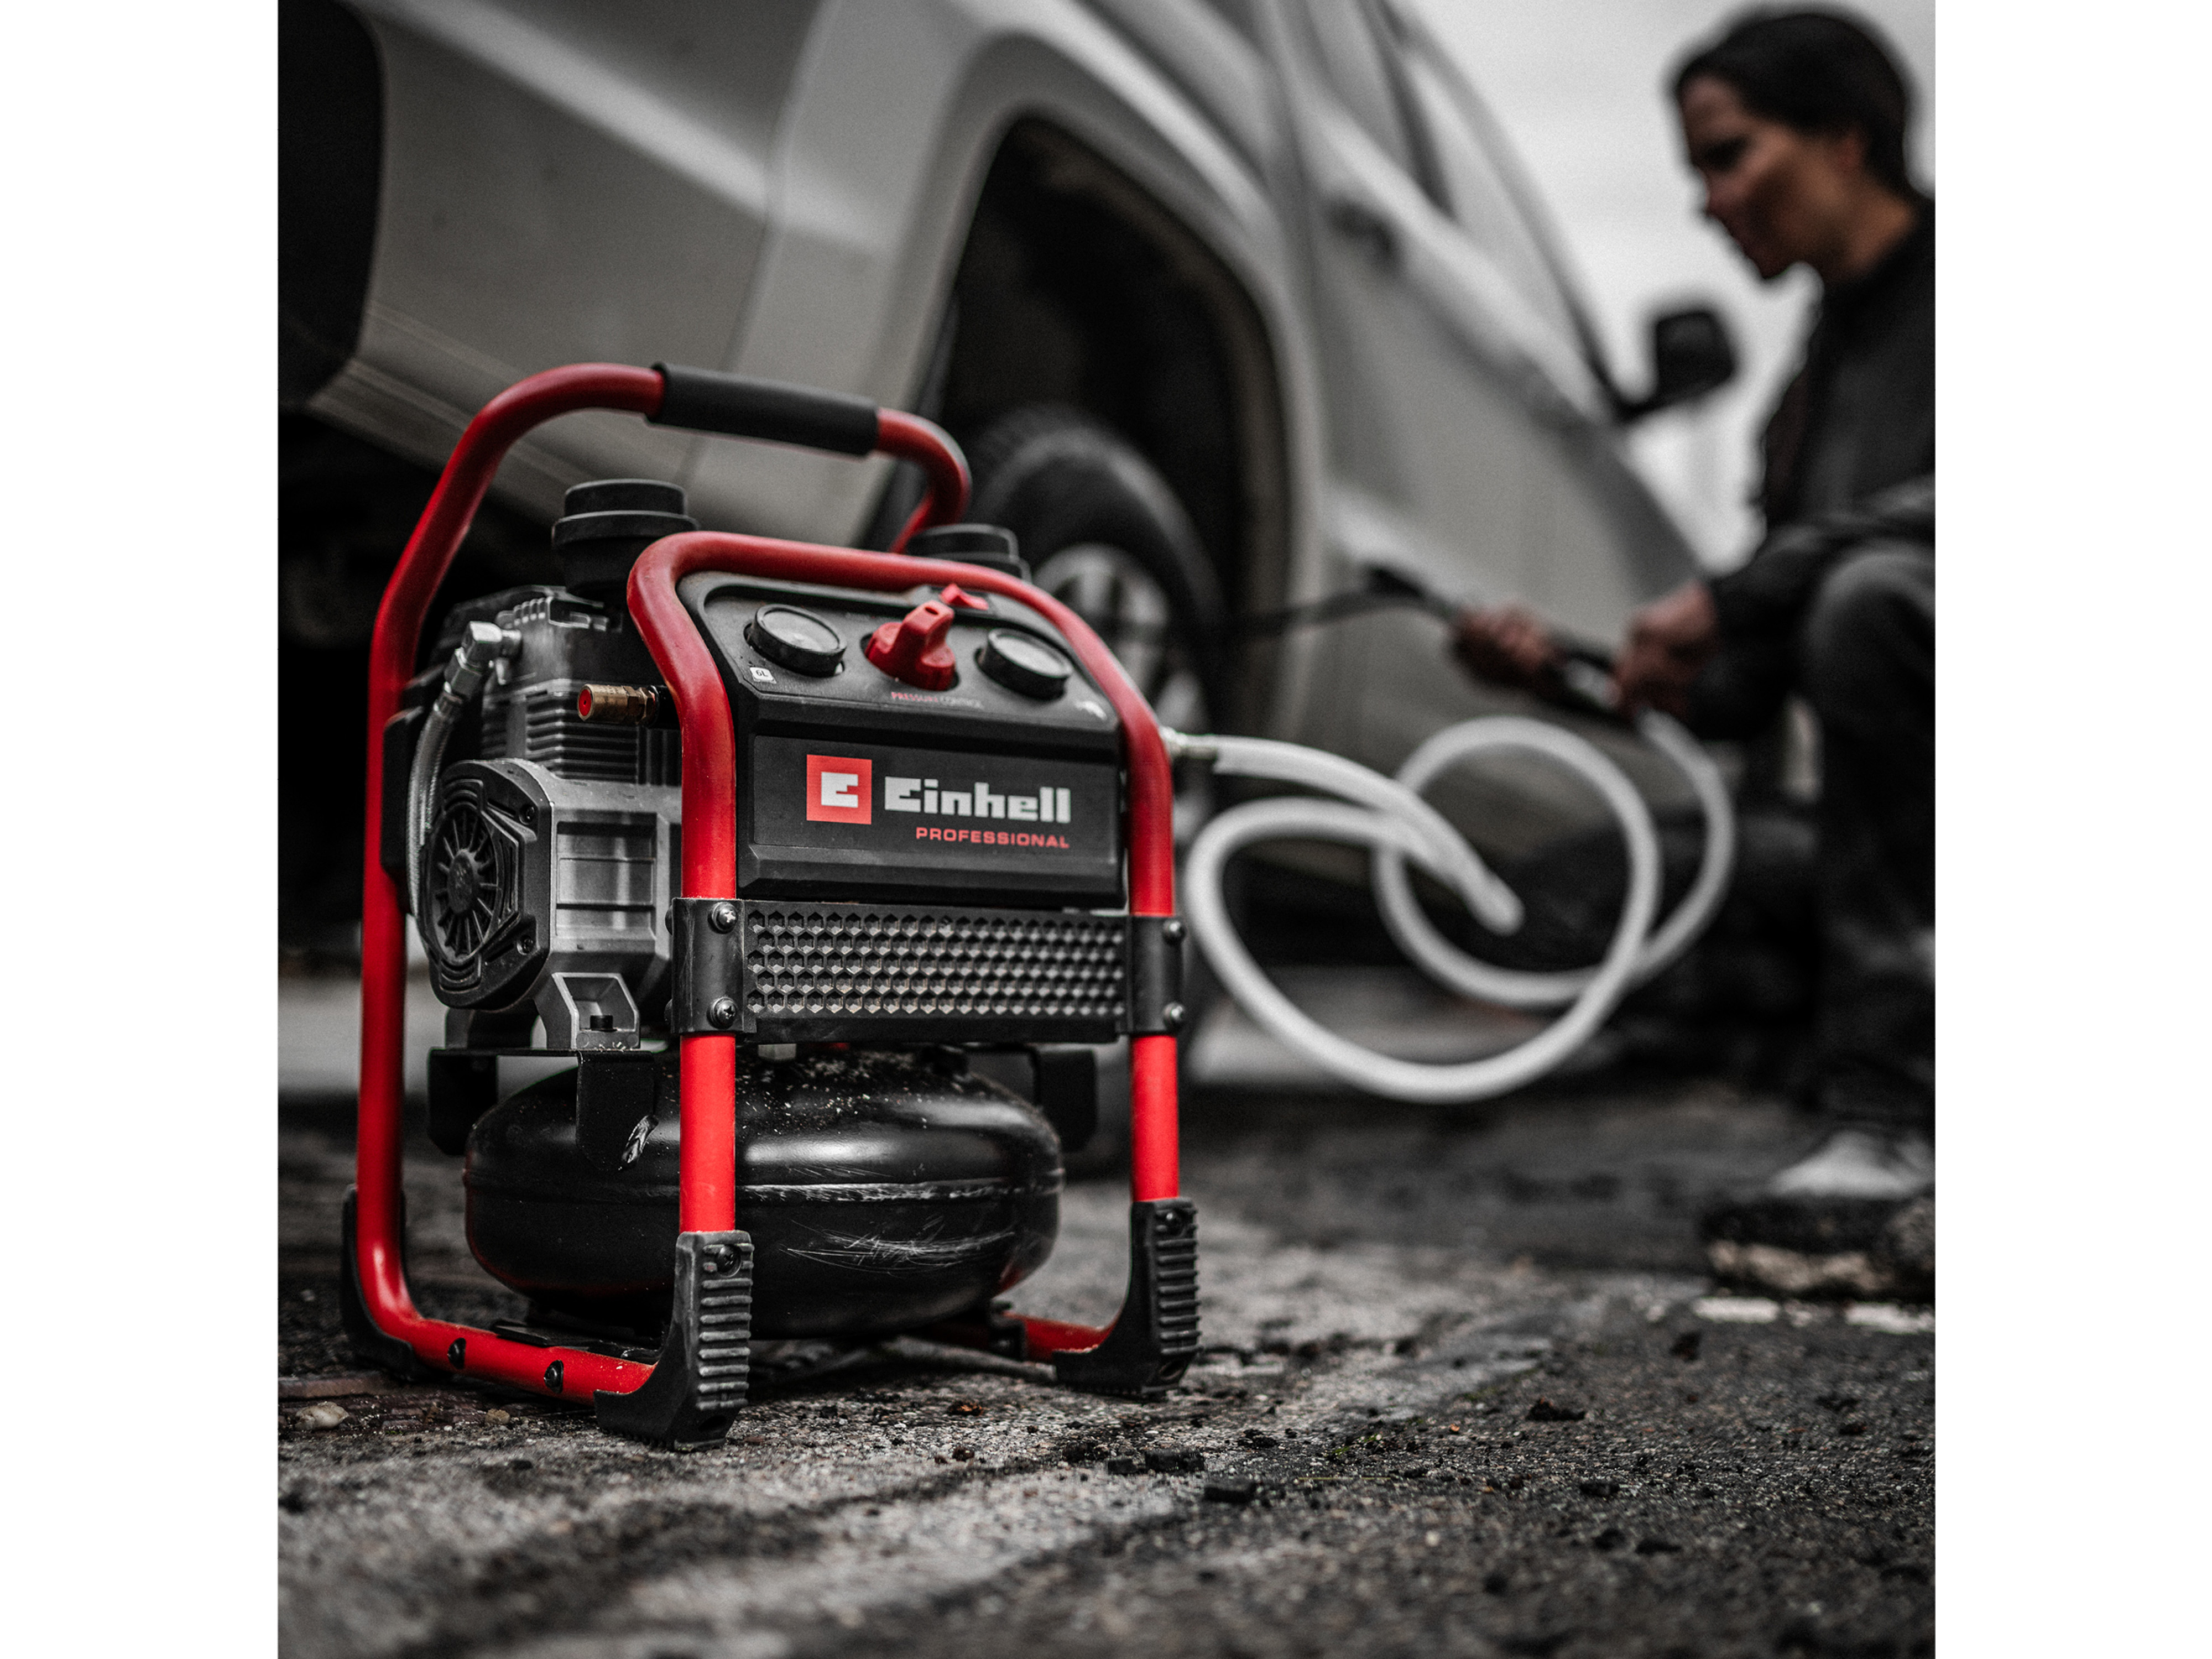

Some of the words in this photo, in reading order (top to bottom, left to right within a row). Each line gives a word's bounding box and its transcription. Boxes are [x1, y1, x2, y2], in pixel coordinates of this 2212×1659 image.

[755, 669, 769, 677] 6L
[885, 776, 1071, 823] Einhell
[916, 827, 1070, 849] PROFESSIONAL
